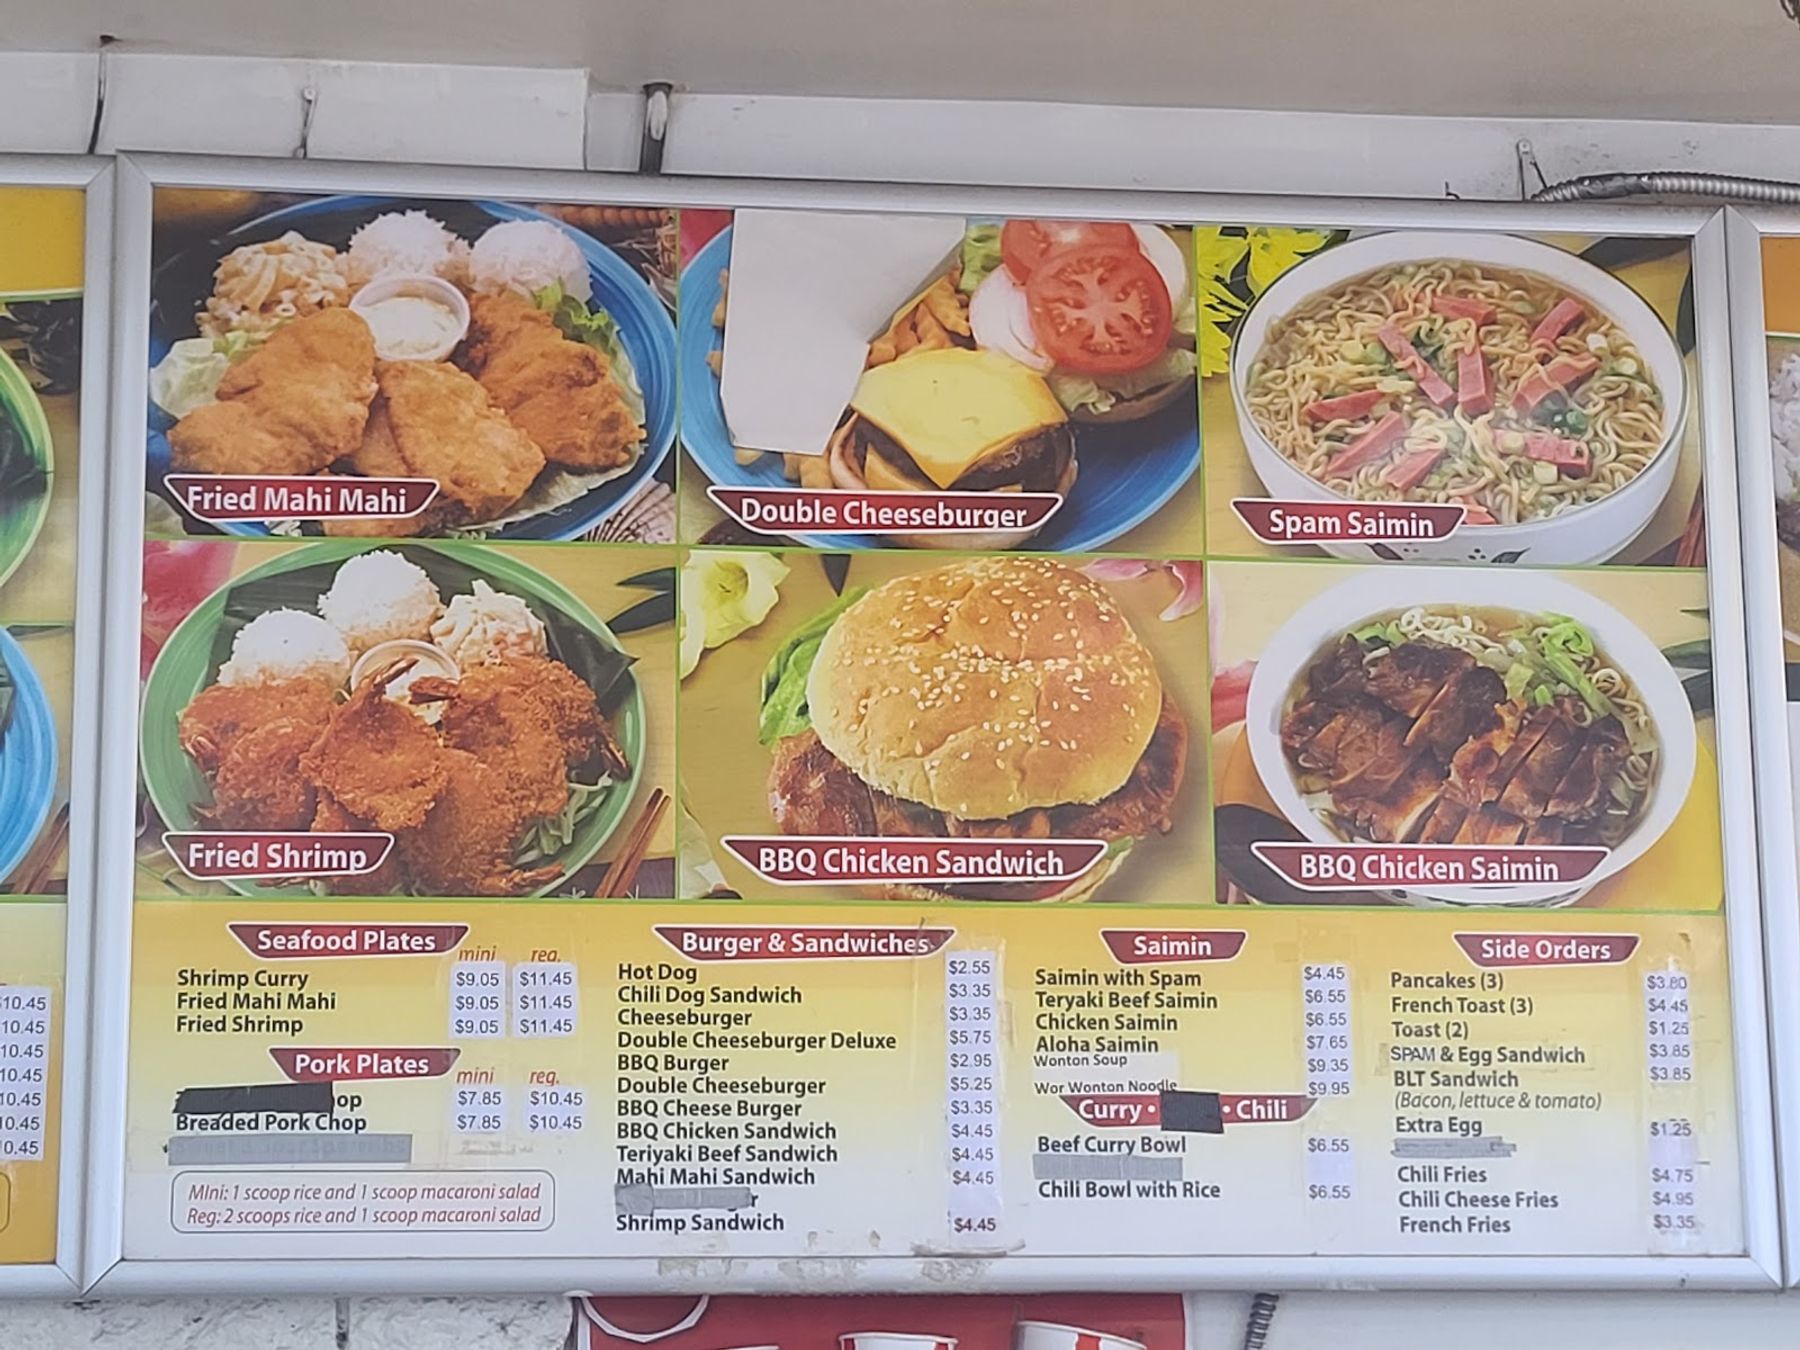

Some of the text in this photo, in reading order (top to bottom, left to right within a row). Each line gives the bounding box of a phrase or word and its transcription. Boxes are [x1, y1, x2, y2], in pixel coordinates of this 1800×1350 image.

[187, 486, 406, 513] Fried Mahi Mahi
[742, 499, 1027, 529] Double Cheeseburger
[1270, 509, 1433, 538] Spam Saimin
[189, 843, 367, 871] Fried Shrimp
[760, 848, 1063, 877] BBQ Chicken Sandwich
[1302, 854, 1559, 883] BBQ Chicken Saimin
[257, 930, 436, 951] Seafood Plates
[683, 933, 928, 955] Burger Sandwiches
[1134, 936, 1211, 956] Saimin
[459, 946, 496, 961] mini
[1482, 939, 1611, 960] Side Orders
[618, 964, 698, 984] Hot Dog
[949, 960, 990, 976] $2.55
[1304, 967, 1344, 981] $4.45
[177, 970, 308, 991] Shrimp Curry
[457, 972, 499, 987] $9.05
[520, 972, 572, 986] $11.45
[1036, 969, 1201, 989] Saimin with Spam
[1392, 972, 1503, 991] Pancakes (3)
[618, 987, 801, 1006] Chili Dog Sandwich
[949, 983, 990, 999] $3.35
[1305, 989, 1345, 1004] $6.55
[177, 992, 336, 1010] Fried Mahi Mahi
[456, 996, 499, 1010] $9.05
[520, 996, 572, 1010] $11.45
[1036, 992, 1218, 1011] Teryaki Beef Saimin
[1392, 998, 1533, 1016] French Toast (3)
[618, 1009, 752, 1029] Cheeseburger
[950, 1006, 990, 1022] $3.35
[1036, 1014, 1178, 1031] Chicken Saimin
[1306, 1012, 1346, 1027] $6.55
[177, 1015, 303, 1036] Fried Shrimp
[455, 1019, 498, 1034] $9.05
[520, 1019, 572, 1033] $11.45
[1392, 1022, 1468, 1040] Toast (2)
[618, 1032, 896, 1052] Double Cheeseburger Deluxe
[950, 1030, 991, 1045] $5.75
[1037, 1037, 1158, 1052] Aloha Saimin
[1307, 1036, 1348, 1050] $7.65
[295, 1055, 429, 1074] Pork Plates
[618, 1055, 729, 1074] BBQ Burger
[951, 1053, 991, 1069] $2.95
[1034, 1054, 1127, 1068] Wonton Soup
[1391, 1046, 1585, 1066] SPAM Egg Sandwich
[1308, 1059, 1348, 1073] $9.35
[457, 1068, 495, 1083] mini
[1394, 1071, 1518, 1088] BLT Sandwich
[618, 1077, 826, 1097] Double Cheeseburger
[951, 1077, 992, 1092] $5.25
[1035, 1081, 1124, 1094] Wor Wonton
[1309, 1082, 1349, 1096] $9.95
[458, 1091, 501, 1106] $7.85
[530, 1091, 582, 1106] $10.45
[1395, 1093, 1602, 1111] (Bacon, lettuce tomato)
[617, 1100, 801, 1120] BBQ Cheese Burger
[951, 1100, 992, 1115] $3.35
[1079, 1101, 1142, 1122] Curry
[1236, 1101, 1287, 1119] Chili
[177, 1115, 366, 1134] Breaded Pork Chop
[458, 1115, 501, 1129] $7.85
[530, 1115, 582, 1129] $10.45
[1396, 1117, 1482, 1136] Extra Egg
[617, 1123, 836, 1141] BBQ Chicken Sandwich
[951, 1123, 993, 1139] $4.45
[1038, 1136, 1186, 1156] Beef Curry Bowl
[1308, 1139, 1349, 1152] $6.55
[617, 1145, 837, 1165] Teriyaki Beef Sandwich
[952, 1147, 993, 1162] $4.45
[617, 1169, 815, 1185] Mahi Mahi Sandwich
[953, 1170, 994, 1186] $4.45
[1398, 1167, 1487, 1183] Chili Fries
[245, 1183, 540, 1203] scoop rice and scoop macaroni salad
[1039, 1181, 1221, 1198] Chili Bowl with Rice
[1309, 1185, 1350, 1199] $6.55
[1399, 1192, 1558, 1209] Chili Cheese Fries
[617, 1214, 783, 1234] Shrimp Sandwich
[954, 1217, 996, 1234] $4.45
[1400, 1217, 1510, 1233] French Fries
